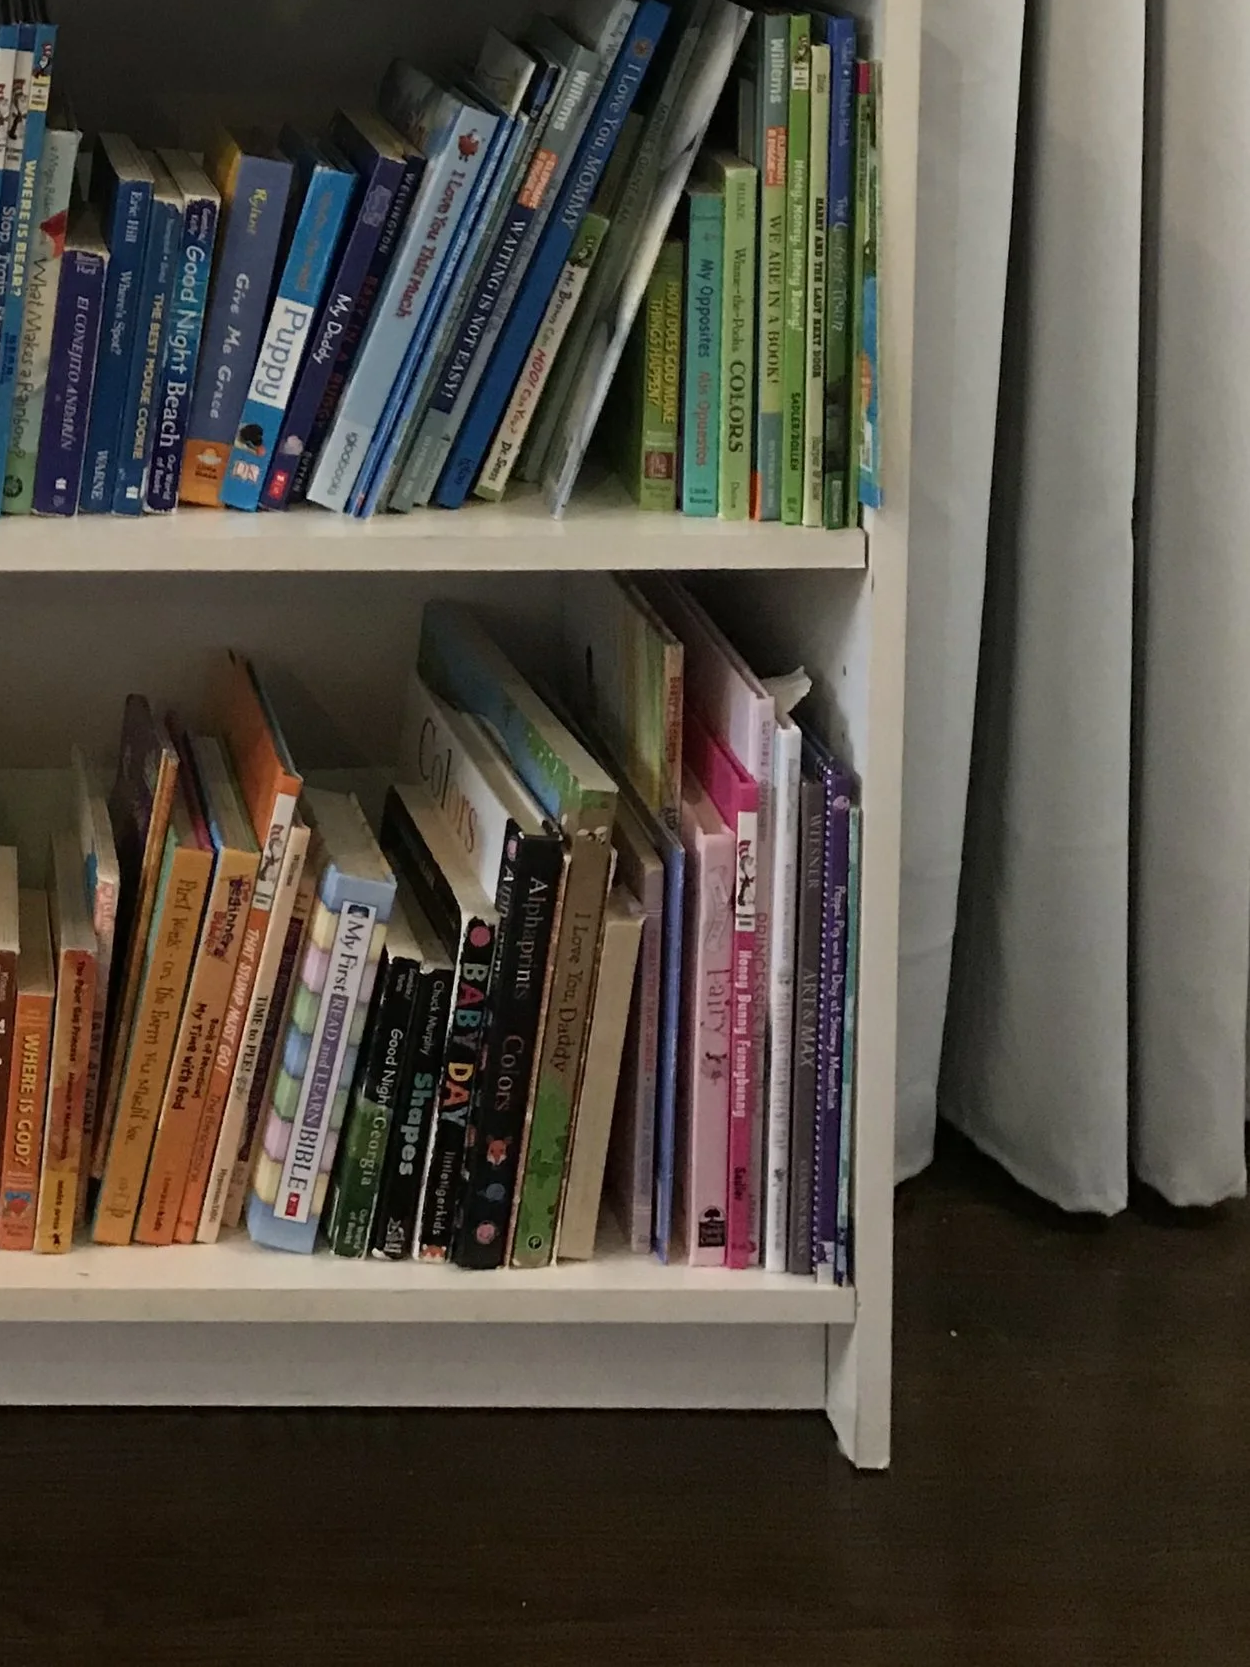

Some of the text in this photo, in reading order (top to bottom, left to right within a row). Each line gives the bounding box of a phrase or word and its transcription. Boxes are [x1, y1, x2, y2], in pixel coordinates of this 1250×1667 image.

[553, 69, 591, 132] Willems
[609, 74, 636, 113] Love
[627, 63, 641, 72] I
[769, 38, 785, 104] Willems
[590, 118, 620, 152] You,
[10, 160, 38, 297] WHERE IS BEAR?
[124, 191, 143, 242] Eric Hill
[560, 155, 602, 230] MOMMY
[397, 169, 466, 319] I Love You This Much
[312, 293, 352, 365] My Daddy
[440, 220, 526, 400] WAITING IS NOT EASY!
[696, 259, 714, 358] My Opposites
[766, 216, 782, 384] WE ARE IN A BOOK!
[10, 258, 48, 458] What Makes a Rainbow?
[67, 313, 86, 383] CONEJITO
[159, 246, 206, 448] Good Night Beach
[208, 273, 250, 420] Give Me Grace
[255, 306, 307, 401] Puppy
[60, 384, 80, 451] ANDARÍN
[728, 360, 746, 453] COLORS
[91, 450, 109, 500] WARNE
[326, 432, 359, 496] igloobooks
[488, 441, 513, 482] Dr. Seuss
[418, 716, 478, 854] Colors
[568, 925, 587, 965] Love
[418, 980, 445, 1057] Chuck Murphy
[562, 969, 586, 1003] You,
[171, 1002, 208, 1111] My Time with God
[240, 1043, 259, 1072] PEE!
[248, 1029, 262, 1041] to
[287, 919, 364, 1191] My First READ and LEARN BIBLE
[440, 962, 490, 1129] BABY DAY
[550, 1007, 579, 1073] Daddy
[732, 949, 753, 1118] Honey Bunny Funnybunny
[13, 1032, 40, 1166] WHERE IS GOD?
[359, 1028, 404, 1187] Good Night Georgia
[493, 1034, 525, 1112] Colors
[399, 1072, 434, 1176] Shapes
[431, 1150, 456, 1236] littletigerkids
